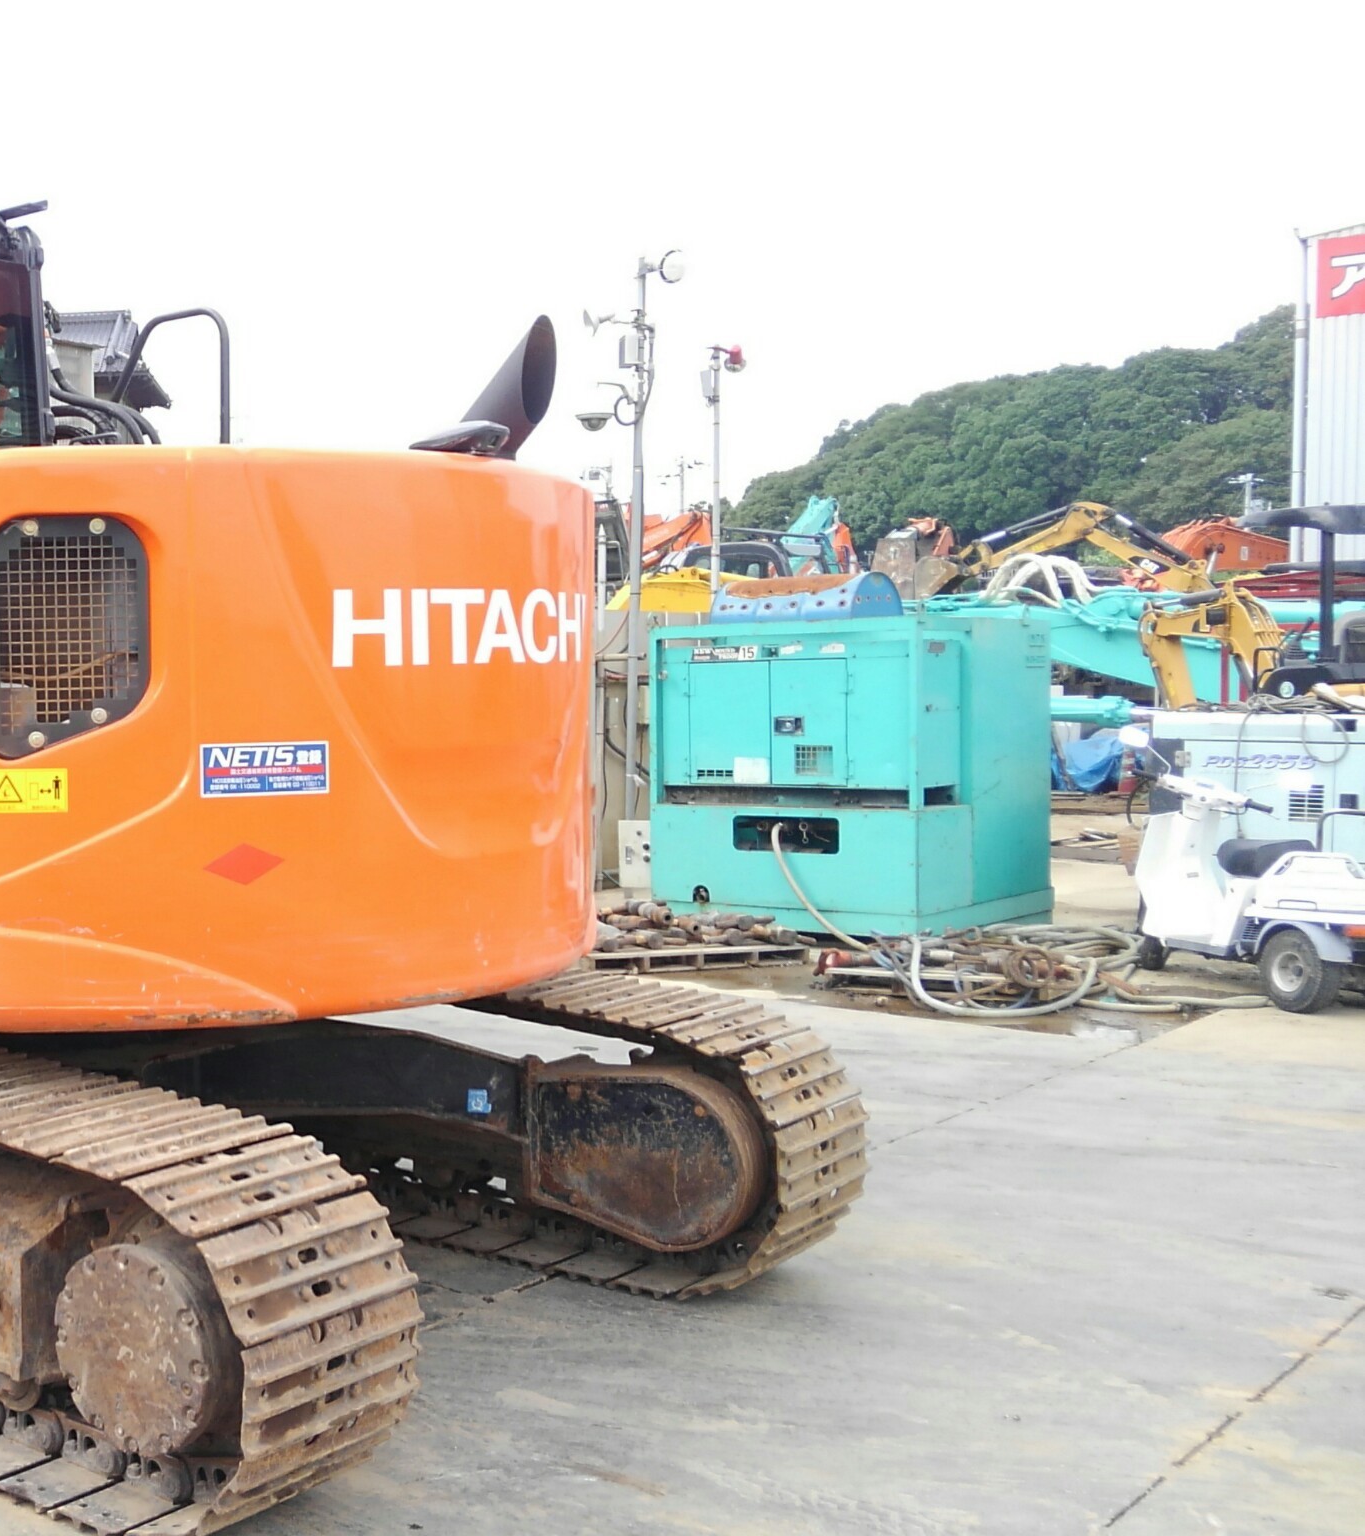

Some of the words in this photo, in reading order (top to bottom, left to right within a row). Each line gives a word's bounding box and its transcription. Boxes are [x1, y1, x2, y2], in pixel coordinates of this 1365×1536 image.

[1140, 558, 1160, 574] CAT
[741, 646, 755, 659] 15
[208, 746, 295, 768] NETIS
